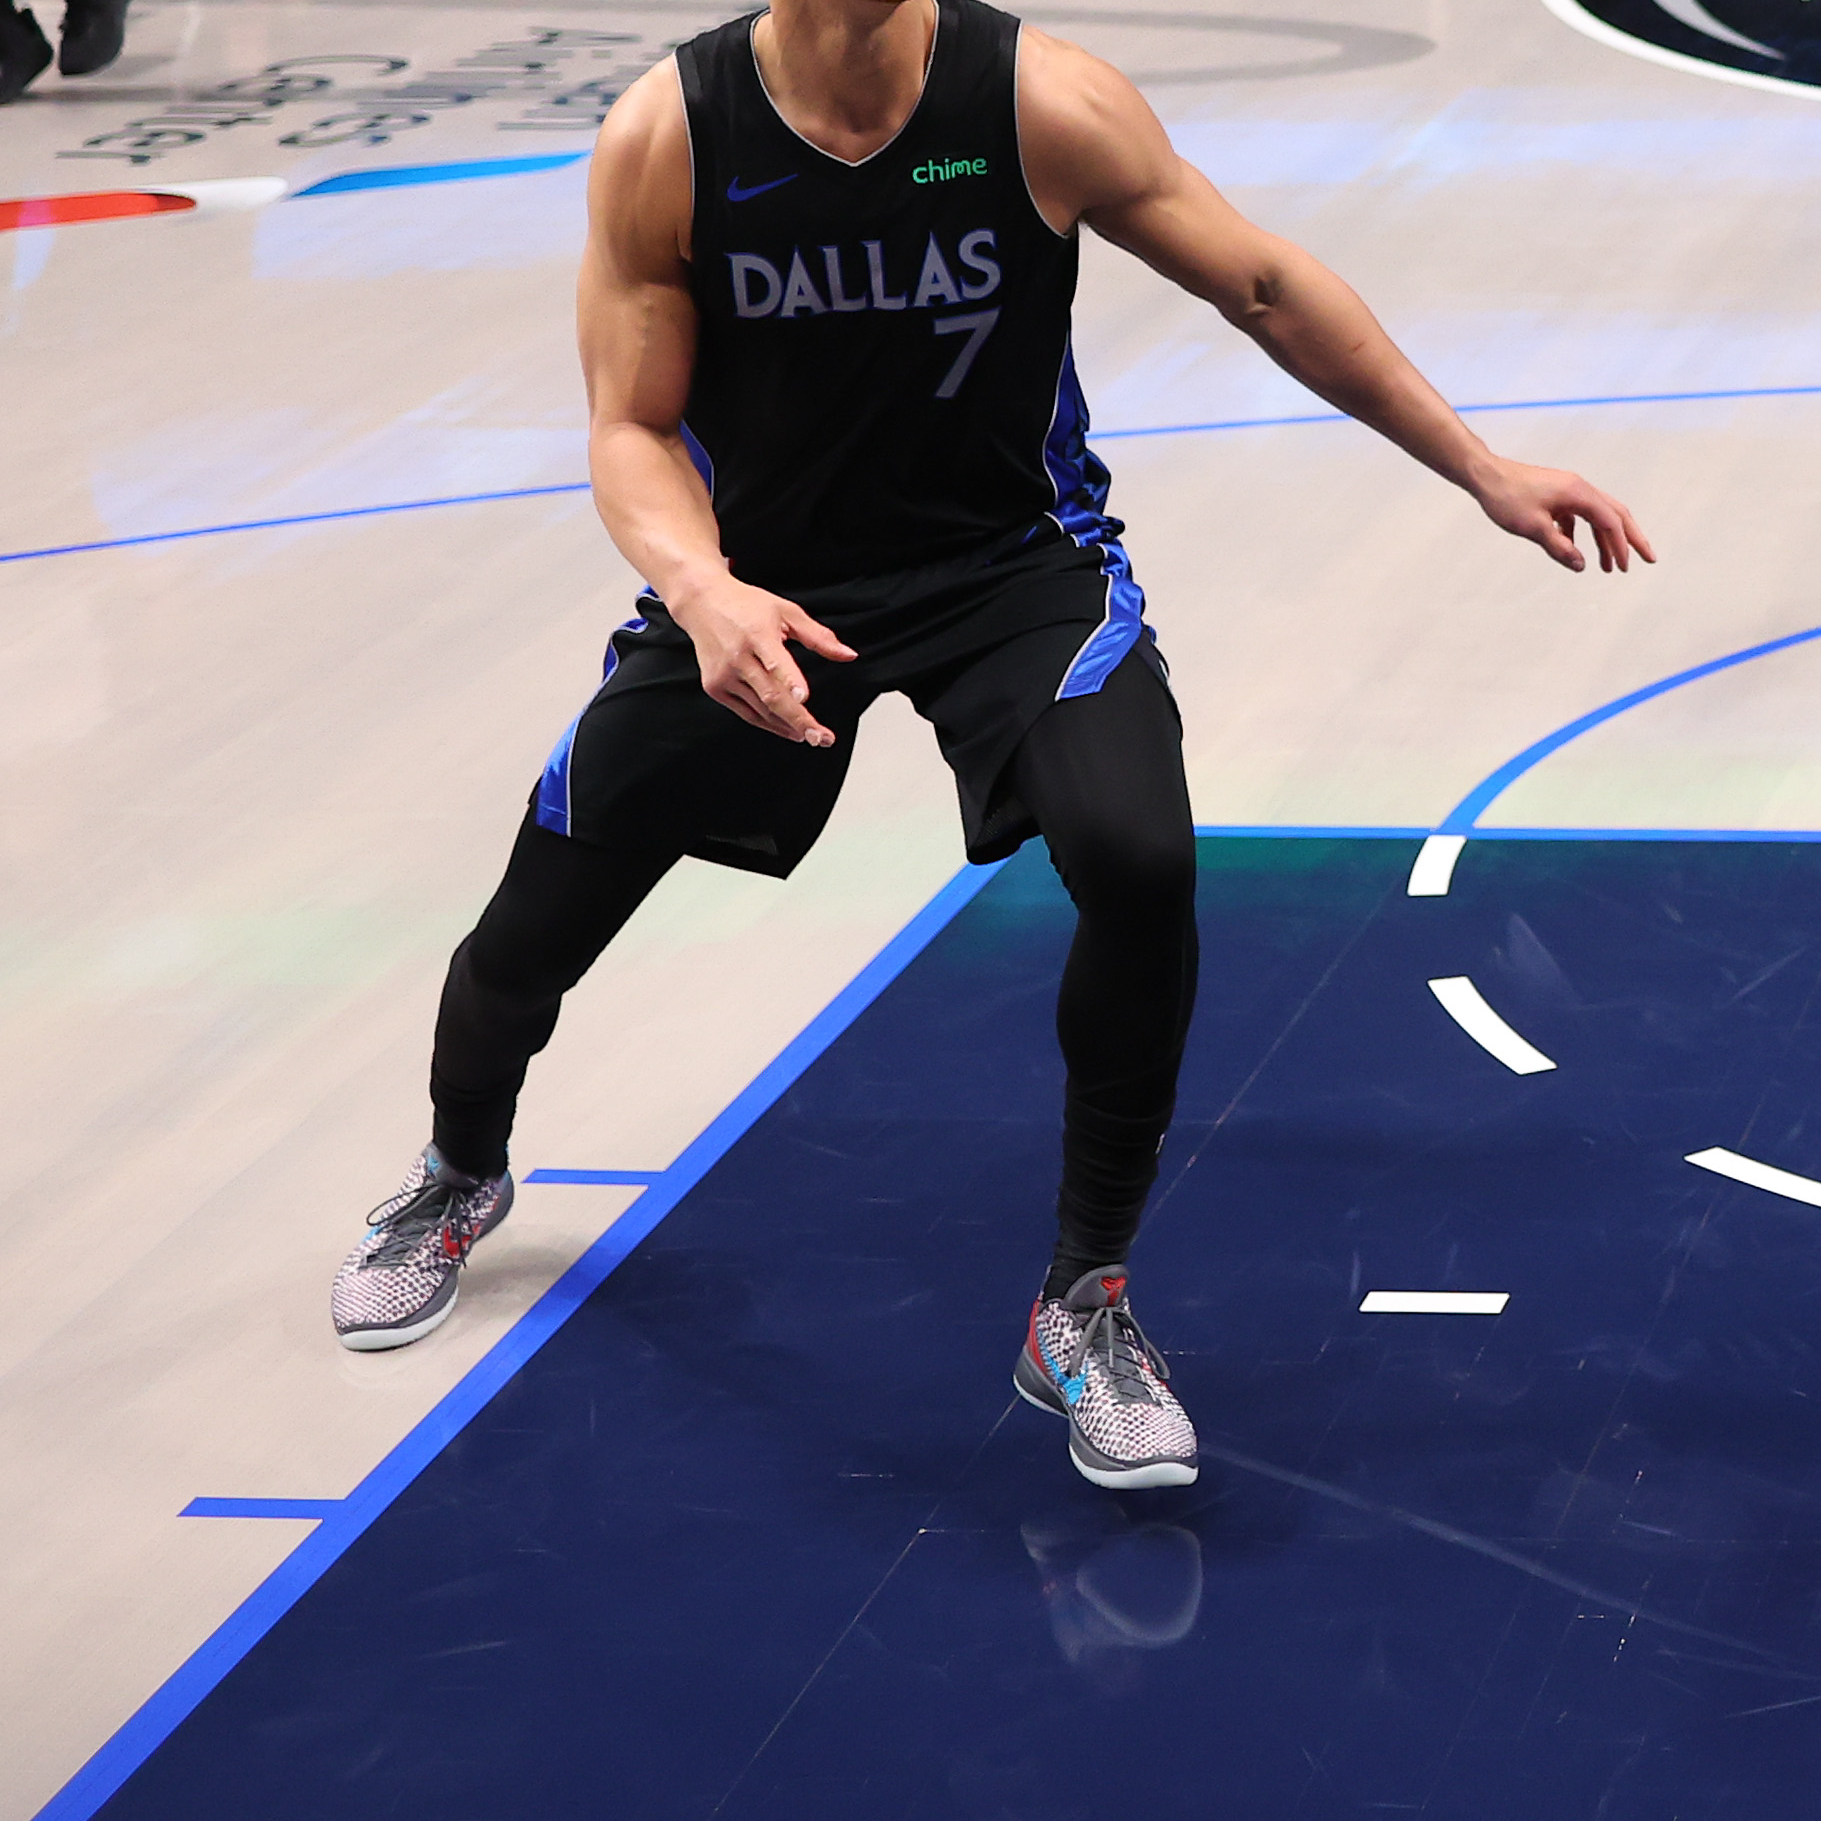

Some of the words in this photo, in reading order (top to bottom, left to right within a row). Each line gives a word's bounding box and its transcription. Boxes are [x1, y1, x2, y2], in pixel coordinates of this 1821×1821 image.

[912, 156, 988, 186] chime
[726, 229, 1002, 319] DALLAS
[933, 306, 1000, 399] 7
